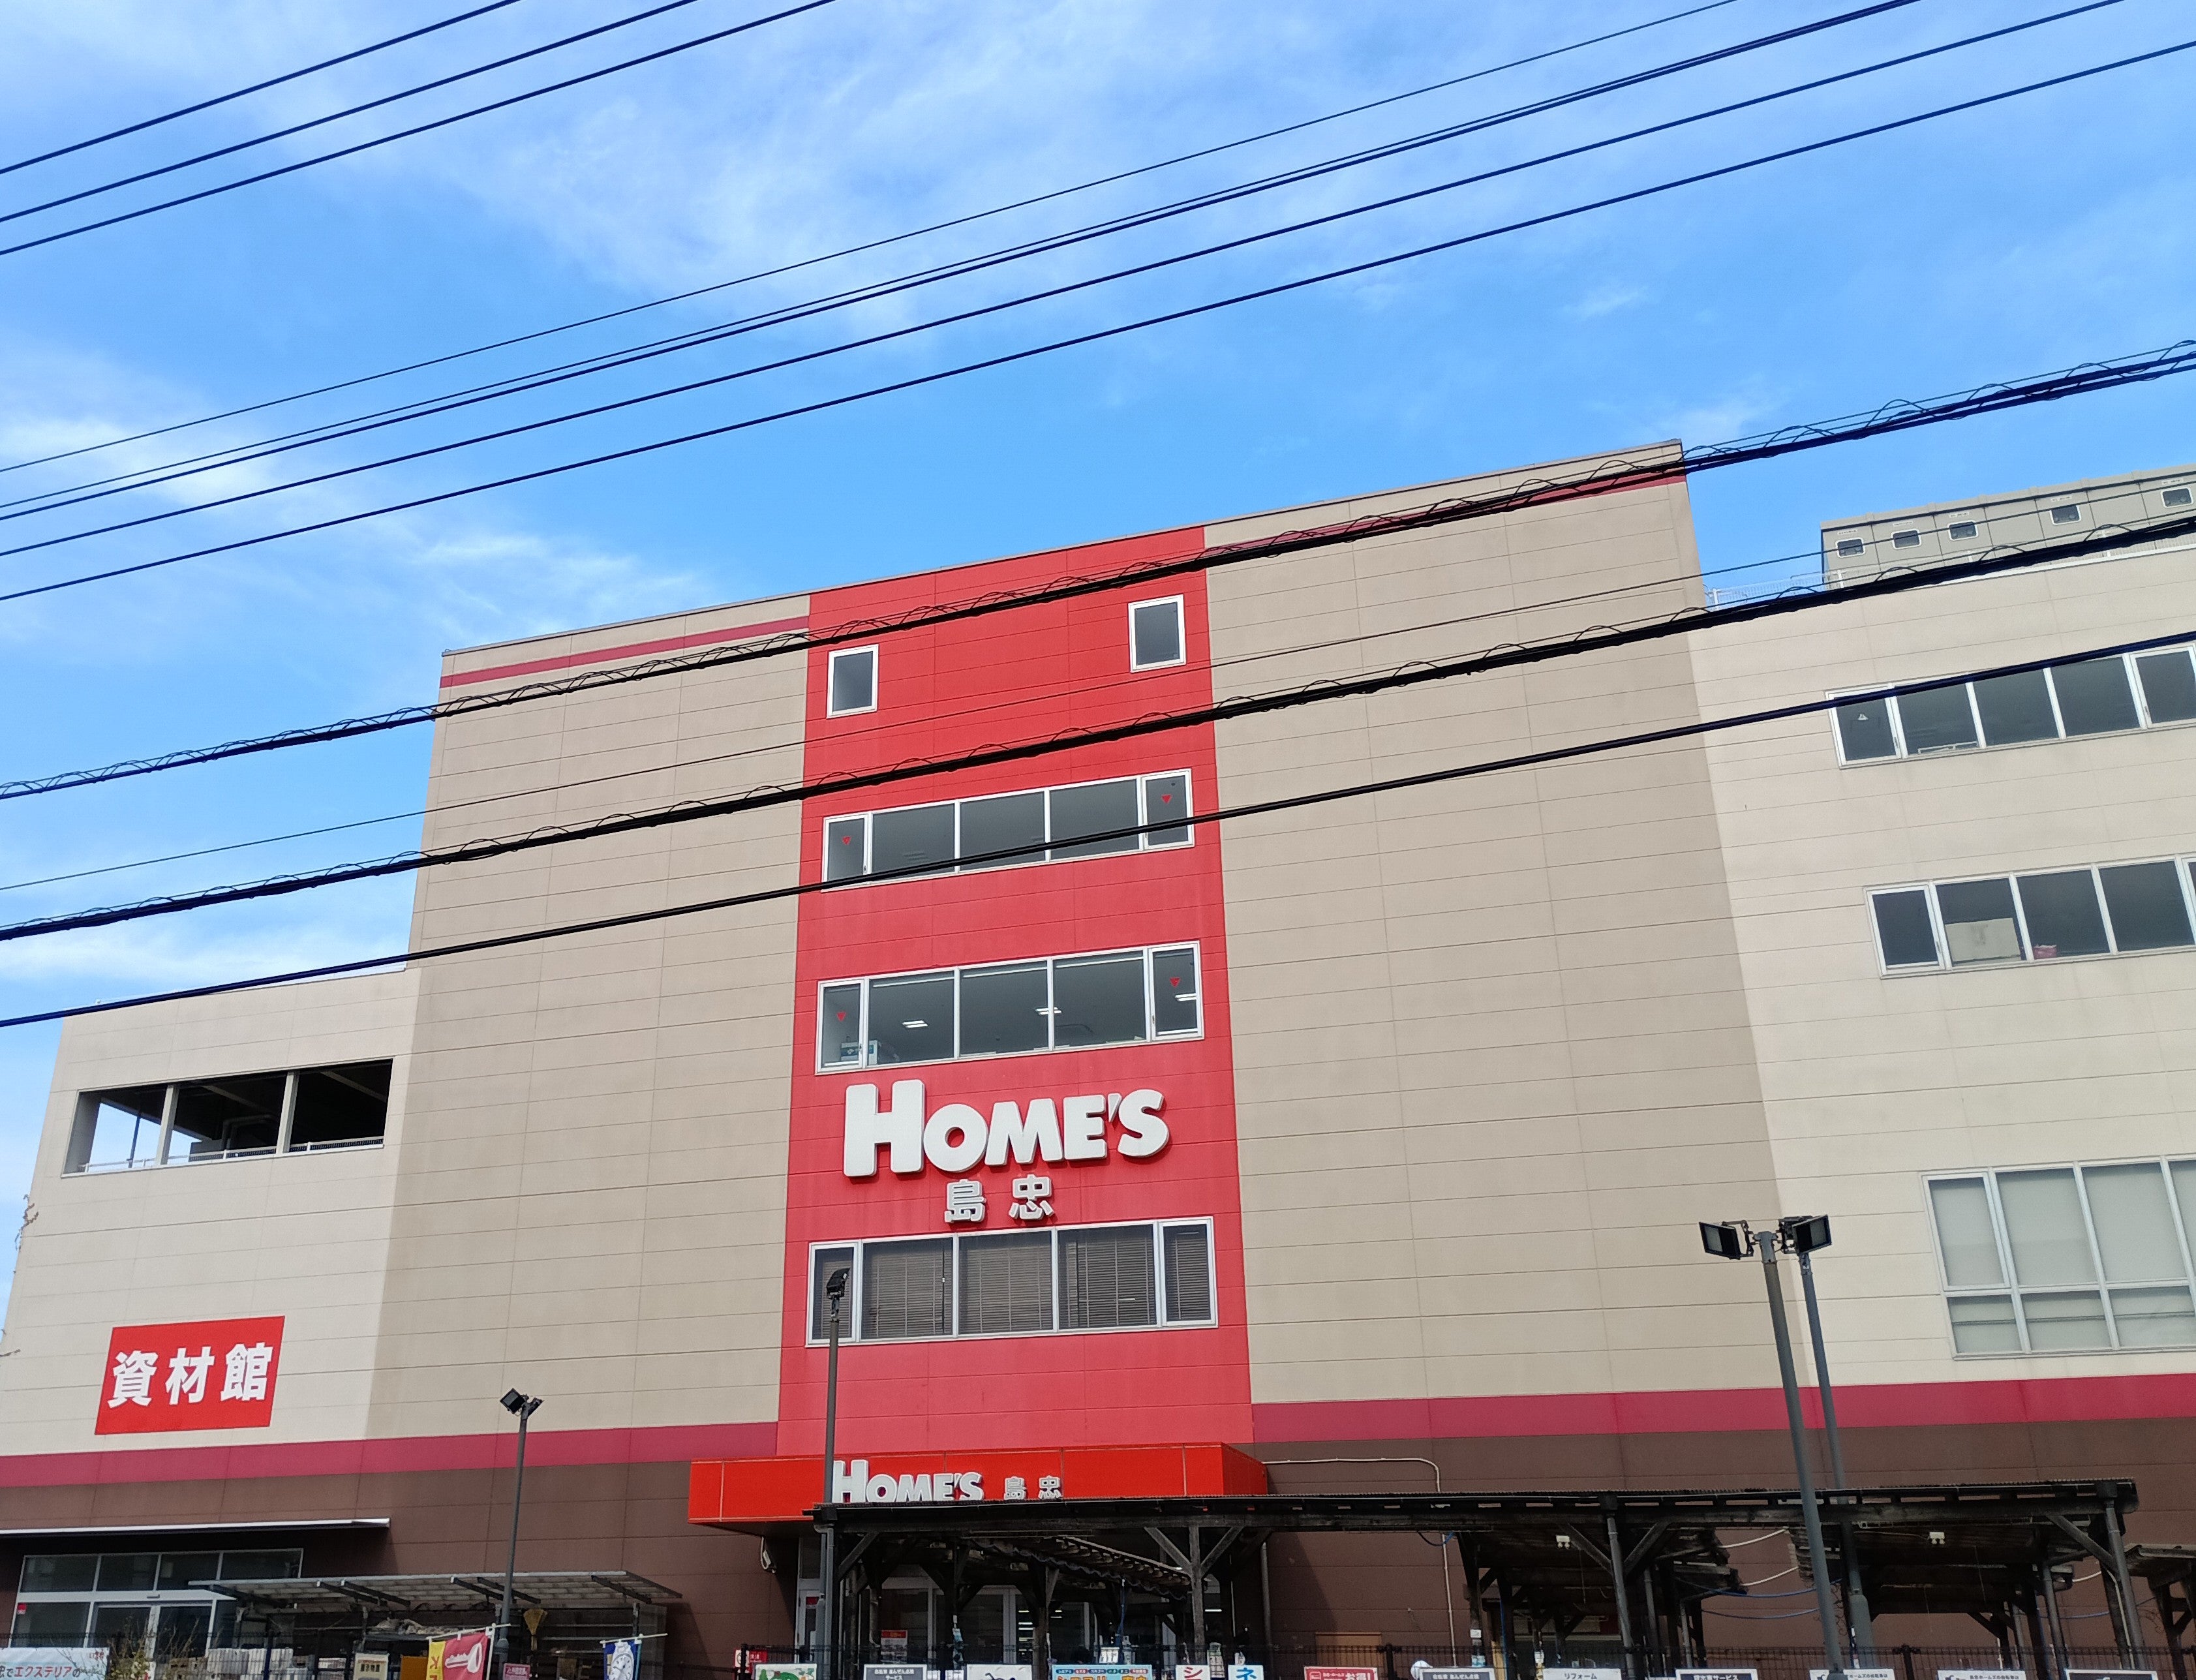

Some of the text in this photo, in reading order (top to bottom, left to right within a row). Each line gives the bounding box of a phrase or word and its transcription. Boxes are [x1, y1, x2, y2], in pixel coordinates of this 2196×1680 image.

[844, 1079, 1170, 1177] HOME'S
[944, 1174, 1054, 1224] 島忠
[108, 1341, 273, 1409] 資材館
[832, 1459, 1063, 1503] HOME'S 島忠
